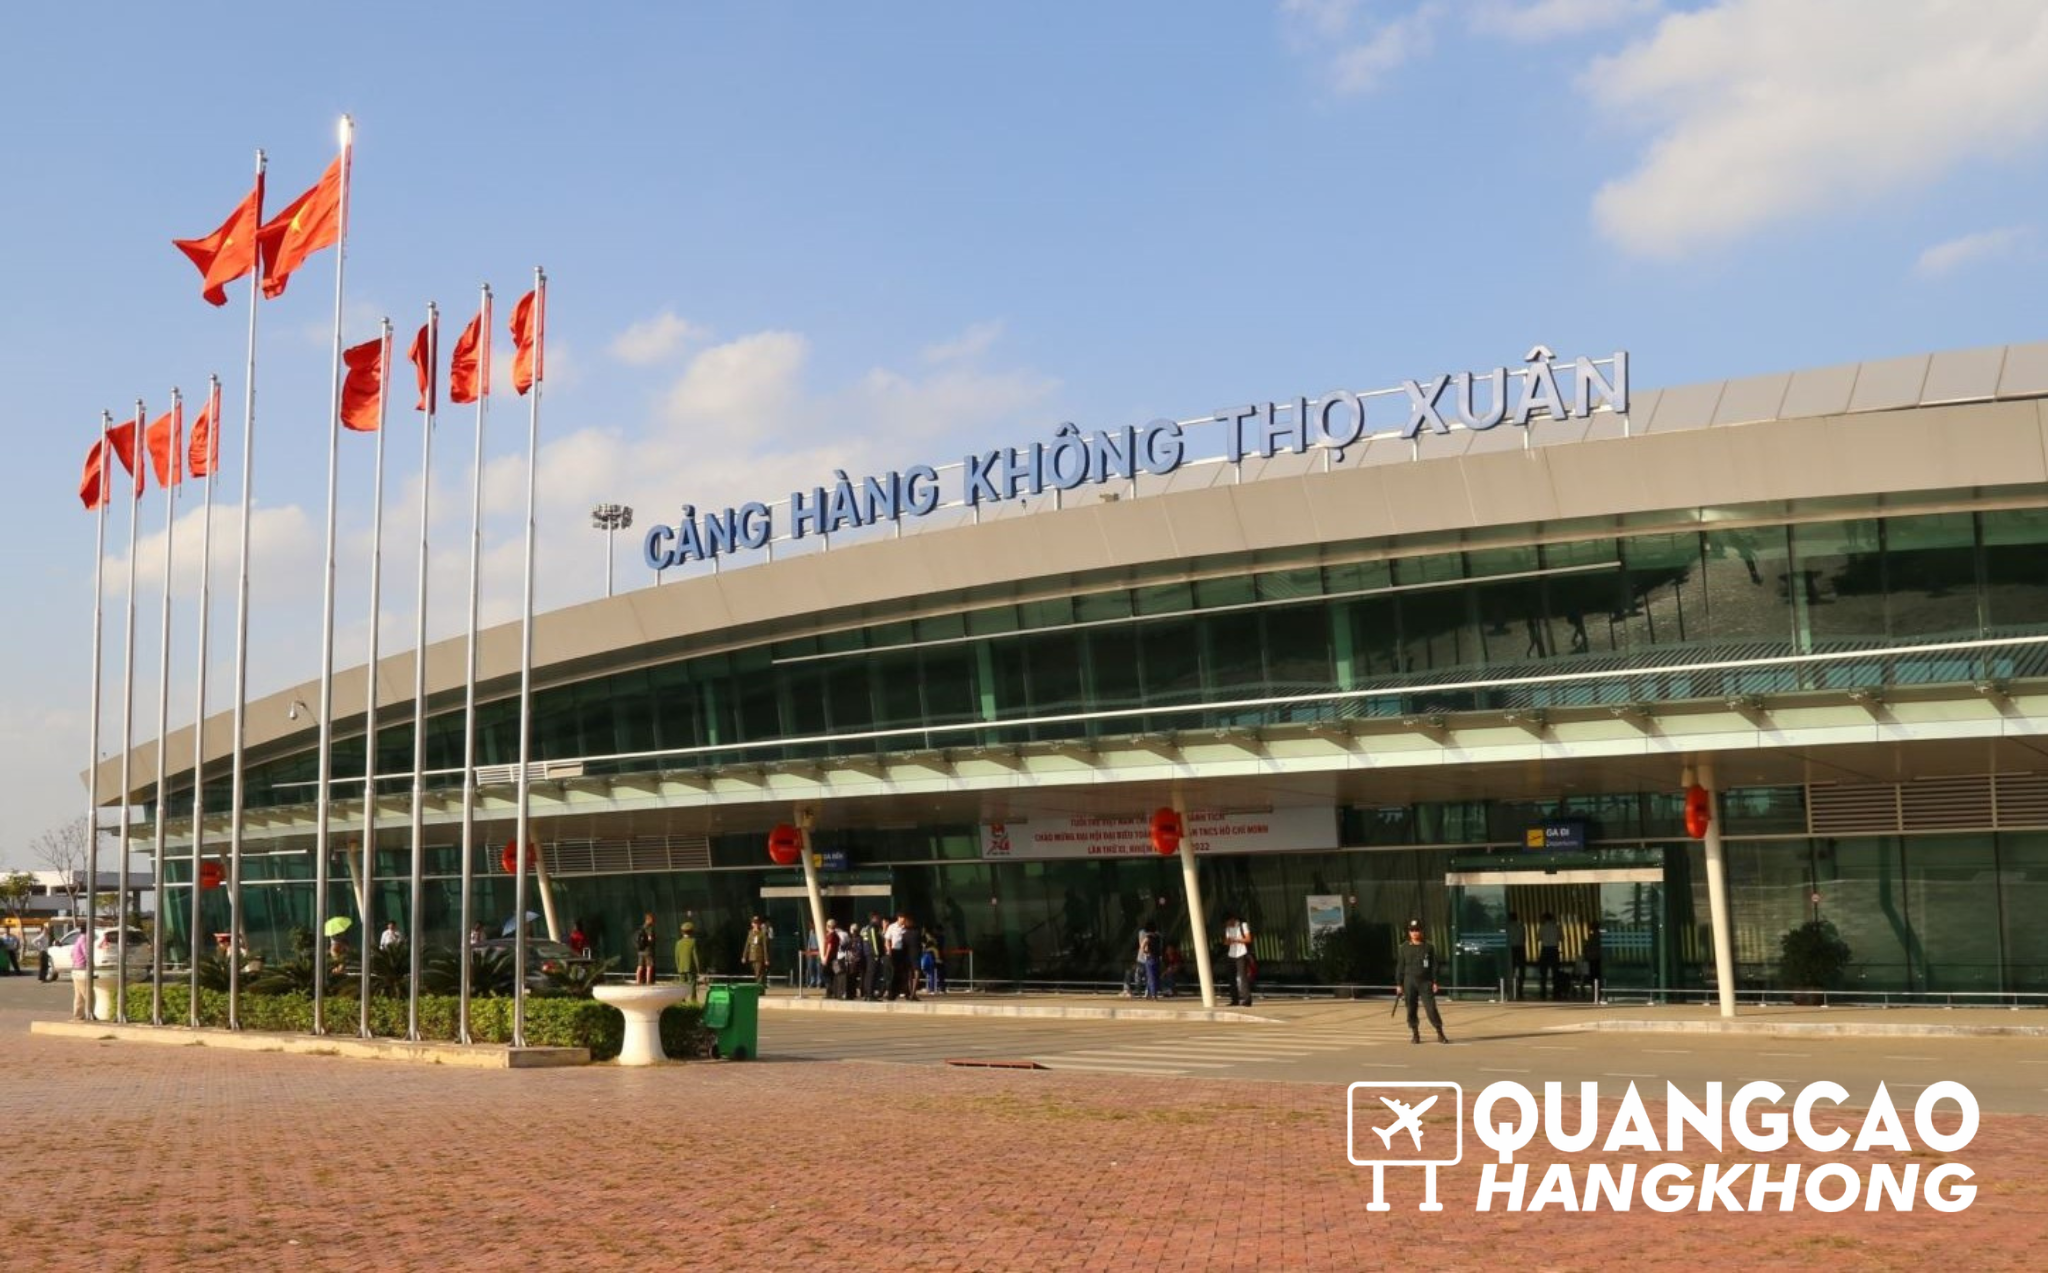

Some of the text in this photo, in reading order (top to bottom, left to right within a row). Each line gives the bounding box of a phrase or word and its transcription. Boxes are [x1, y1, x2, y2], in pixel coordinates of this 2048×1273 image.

[643, 344, 1629, 570] CẢNG HÀNG KHÔNG THỌ XUÂN
